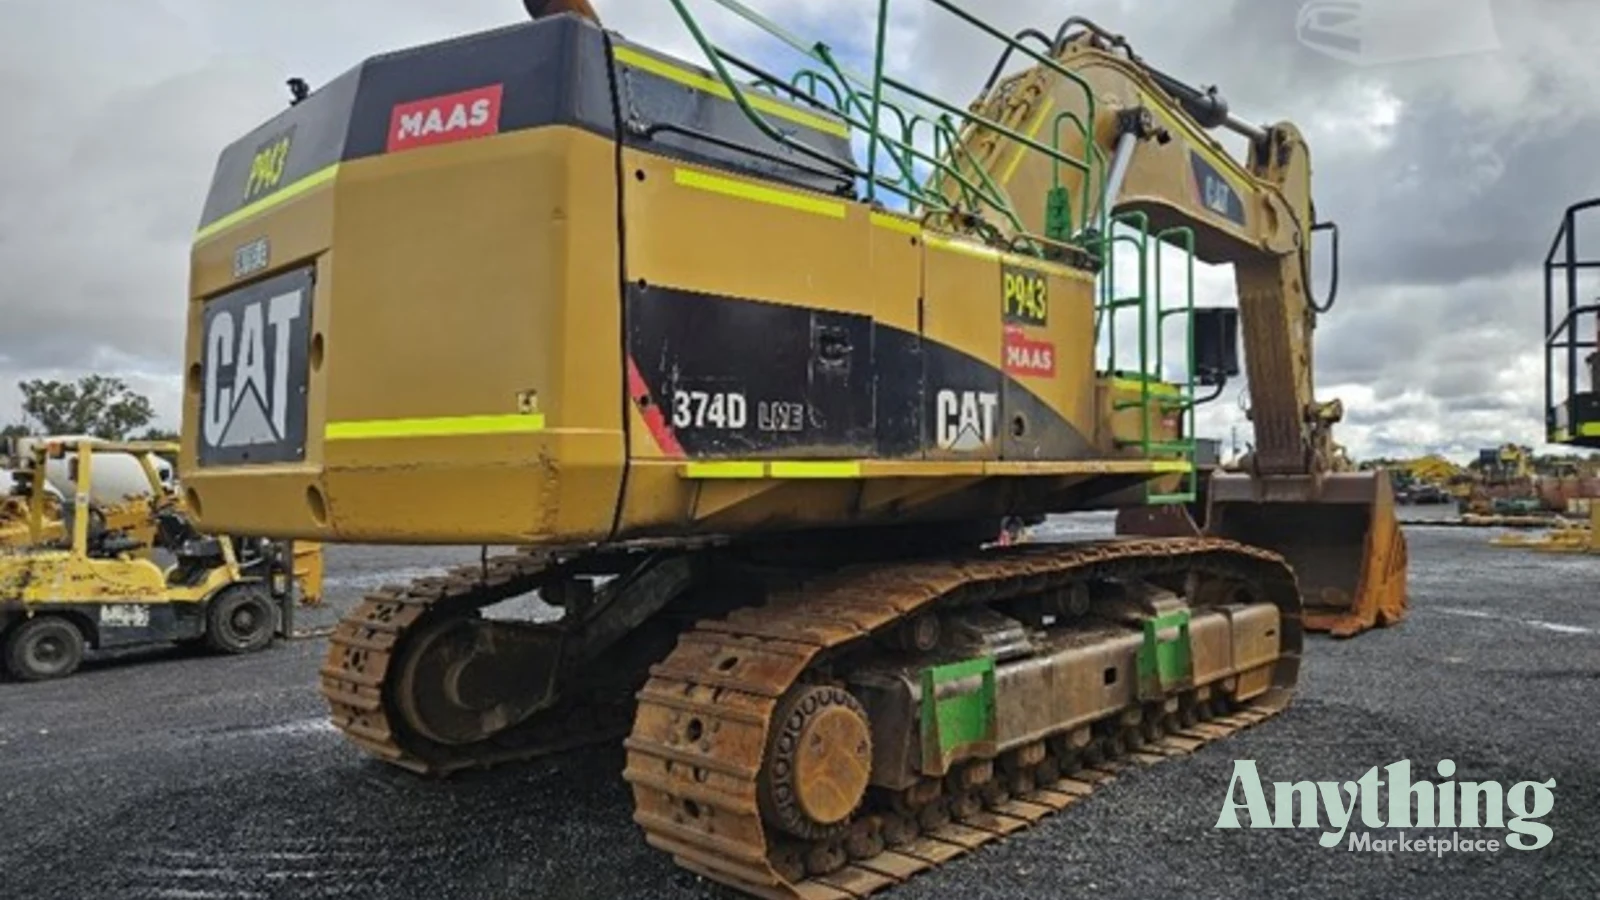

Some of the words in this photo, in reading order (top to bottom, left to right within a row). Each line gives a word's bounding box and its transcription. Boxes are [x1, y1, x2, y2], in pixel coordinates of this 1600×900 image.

[398, 98, 491, 139] MAAS
[1004, 272, 1047, 319] P943
[204, 289, 301, 448] CAT
[1006, 346, 1053, 371] MAAS
[672, 390, 746, 428] 374D
[937, 389, 998, 450] CAT
